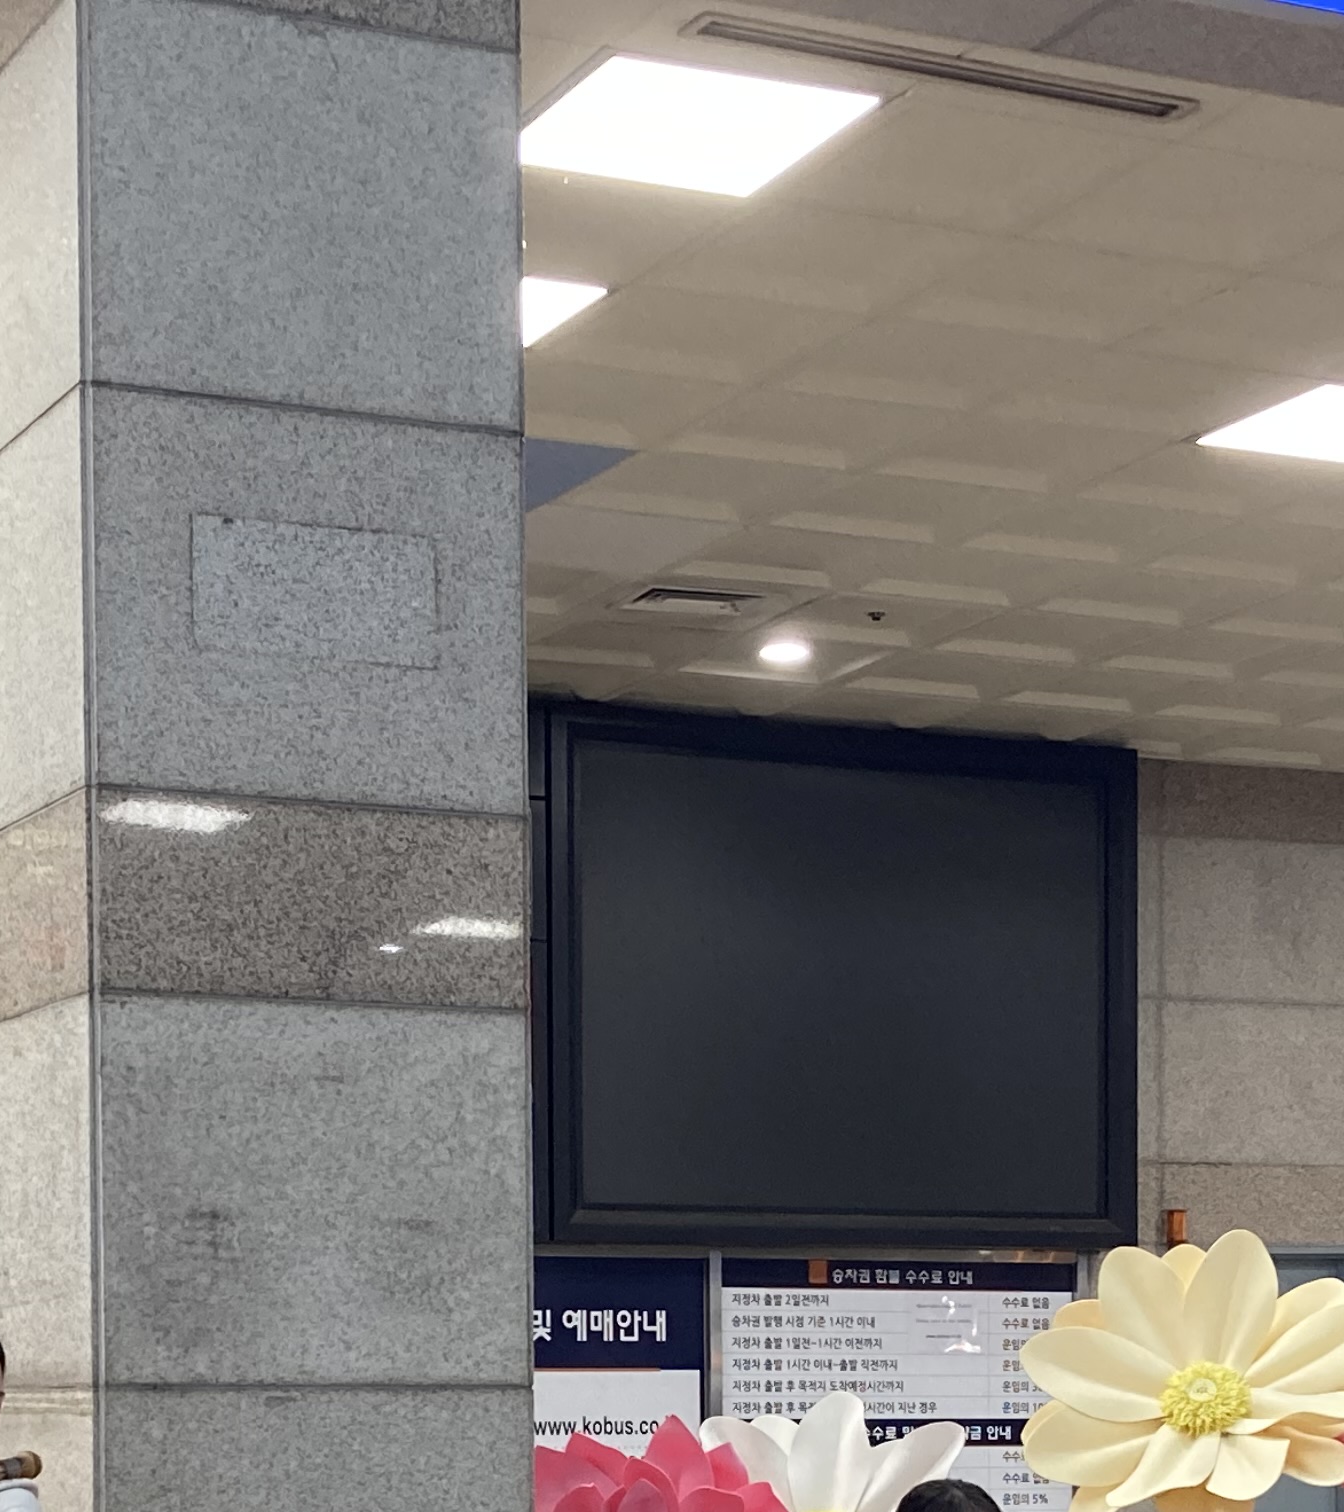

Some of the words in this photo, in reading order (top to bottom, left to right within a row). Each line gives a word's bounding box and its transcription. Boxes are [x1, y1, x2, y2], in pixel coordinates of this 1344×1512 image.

[832, 1268, 870, 1285] 승차권
[906, 1269, 943, 1285] 수수료
[948, 1269, 973, 1286] 안내
[1002, 1296, 1029, 1309] 수수료
[562, 1310, 667, 1342] 예매안내
[830, 1316, 854, 1329] 1시간
[1002, 1317, 1029, 1331] 수수료
[787, 1359, 811, 1372] 1시간
[786, 1380, 795, 1393] 후
[786, 1402, 795, 1414] 후
[987, 1425, 1012, 1440] 안내
[1033, 1494, 1048, 1504] 5%
